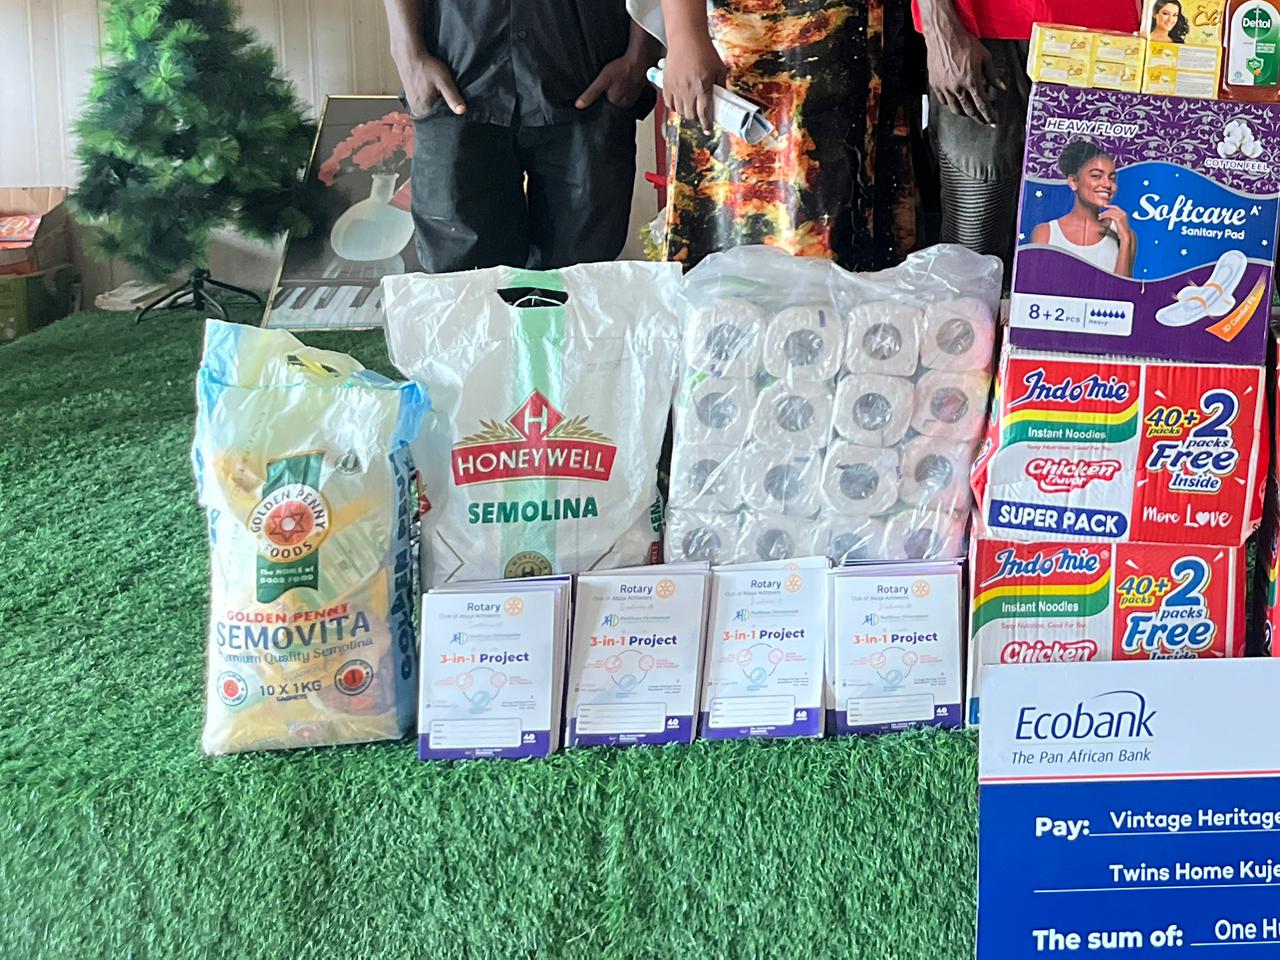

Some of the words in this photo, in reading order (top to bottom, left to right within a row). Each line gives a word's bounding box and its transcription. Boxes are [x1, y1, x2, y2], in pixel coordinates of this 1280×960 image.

[1243, 17, 1270, 29] Dettol
[1046, 118, 1094, 134] HEAVY
[1094, 121, 1138, 137] FLOW
[1205, 158, 1243, 171] COTTON
[1245, 161, 1270, 172] FEEL
[1132, 193, 1246, 230] Softcare
[1181, 225, 1222, 240] Sanitary
[1224, 227, 1245, 240] Pad
[1008, 368, 1129, 408] Indomie
[525, 405, 547, 434] H
[457, 448, 606, 477] HONEYWELL
[1027, 459, 1113, 477] Chicken
[251, 488, 291, 533] GOLDEN
[296, 487, 327, 530] PENNY
[468, 496, 599, 524] SEMOLINA
[998, 504, 1057, 528] SUPER
[1063, 510, 1119, 533] PACK
[980, 548, 1099, 587] Indomie
[620, 584, 653, 595] Rotary
[751, 579, 781, 590] Rotary
[877, 585, 908, 596] Rotary
[227, 610, 287, 623] GOLDEN
[292, 602, 349, 622] PENNY
[467, 602, 501, 613] Rotary
[217, 611, 370, 650] SEMOVITA
[723, 631, 756, 641] 3-in-1
[759, 628, 805, 641] Project
[853, 634, 888, 644] 3-in-1
[891, 632, 938, 644] Project
[590, 636, 625, 647] 3-in-1
[629, 635, 677, 647] Project
[265, 652, 310, 665] Quality
[313, 638, 373, 659] Semolina
[440, 653, 476, 664] 3-in-1
[480, 652, 529, 664] Project
[260, 685, 274, 697] 10
[279, 683, 288, 694] X
[294, 680, 322, 693] 1KG
[1016, 690, 1157, 740] Ecobank
[1012, 751, 1034, 765] The
[1040, 751, 1063, 763] Pan
[1068, 749, 1113, 763] African
[1119, 748, 1151, 762] Bank
[1035, 817, 1090, 840] Pay:
[1110, 811, 1192, 832] Vintage
[1109, 863, 1170, 882] Twins
[1176, 863, 1234, 880] Home
[1032, 929, 1081, 951] The
[1088, 932, 1143, 950] sum
[1150, 925, 1183, 947] of:
[1215, 919, 1257, 941] One
